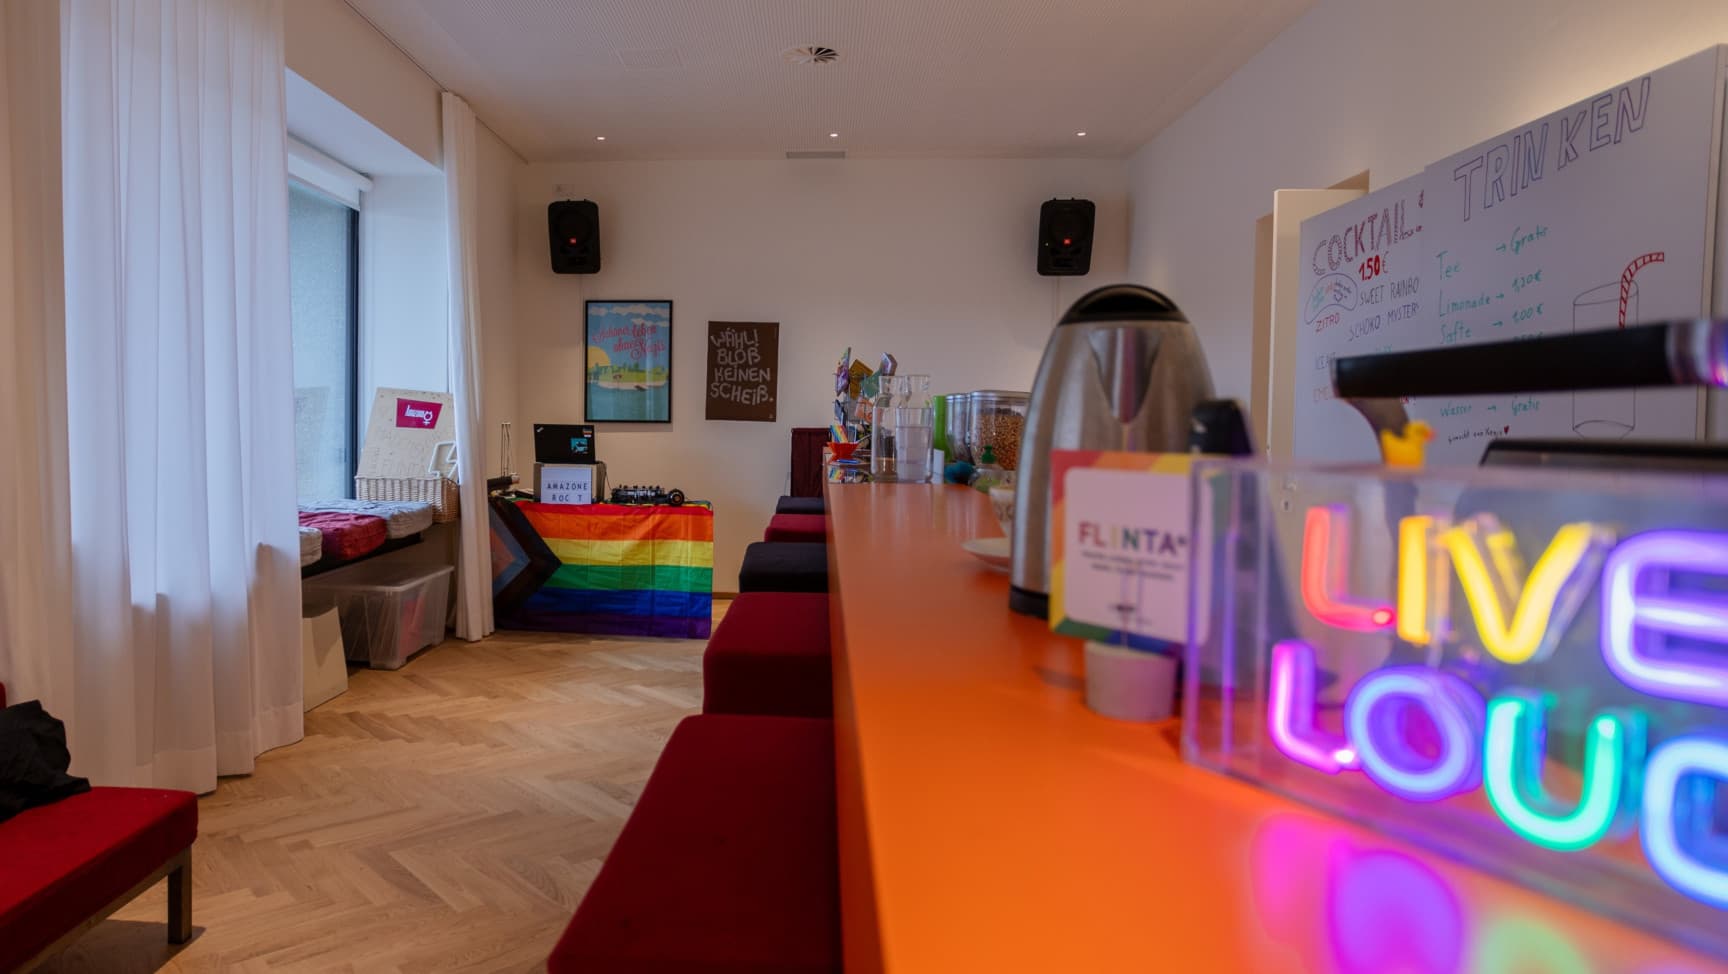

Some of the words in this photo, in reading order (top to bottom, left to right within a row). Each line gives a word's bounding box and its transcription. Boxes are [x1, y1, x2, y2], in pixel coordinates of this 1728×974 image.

[1312, 191, 1424, 276] COCKTAIL
[1360, 285, 1384, 306] SWEET
[1315, 312, 1340, 333] ZITRO
[1348, 314, 1381, 342] SCHOKO
[710, 327, 759, 349] WÄHL!
[547, 482, 588, 490] AMAZONE
[1302, 505, 1728, 706] LIVE
